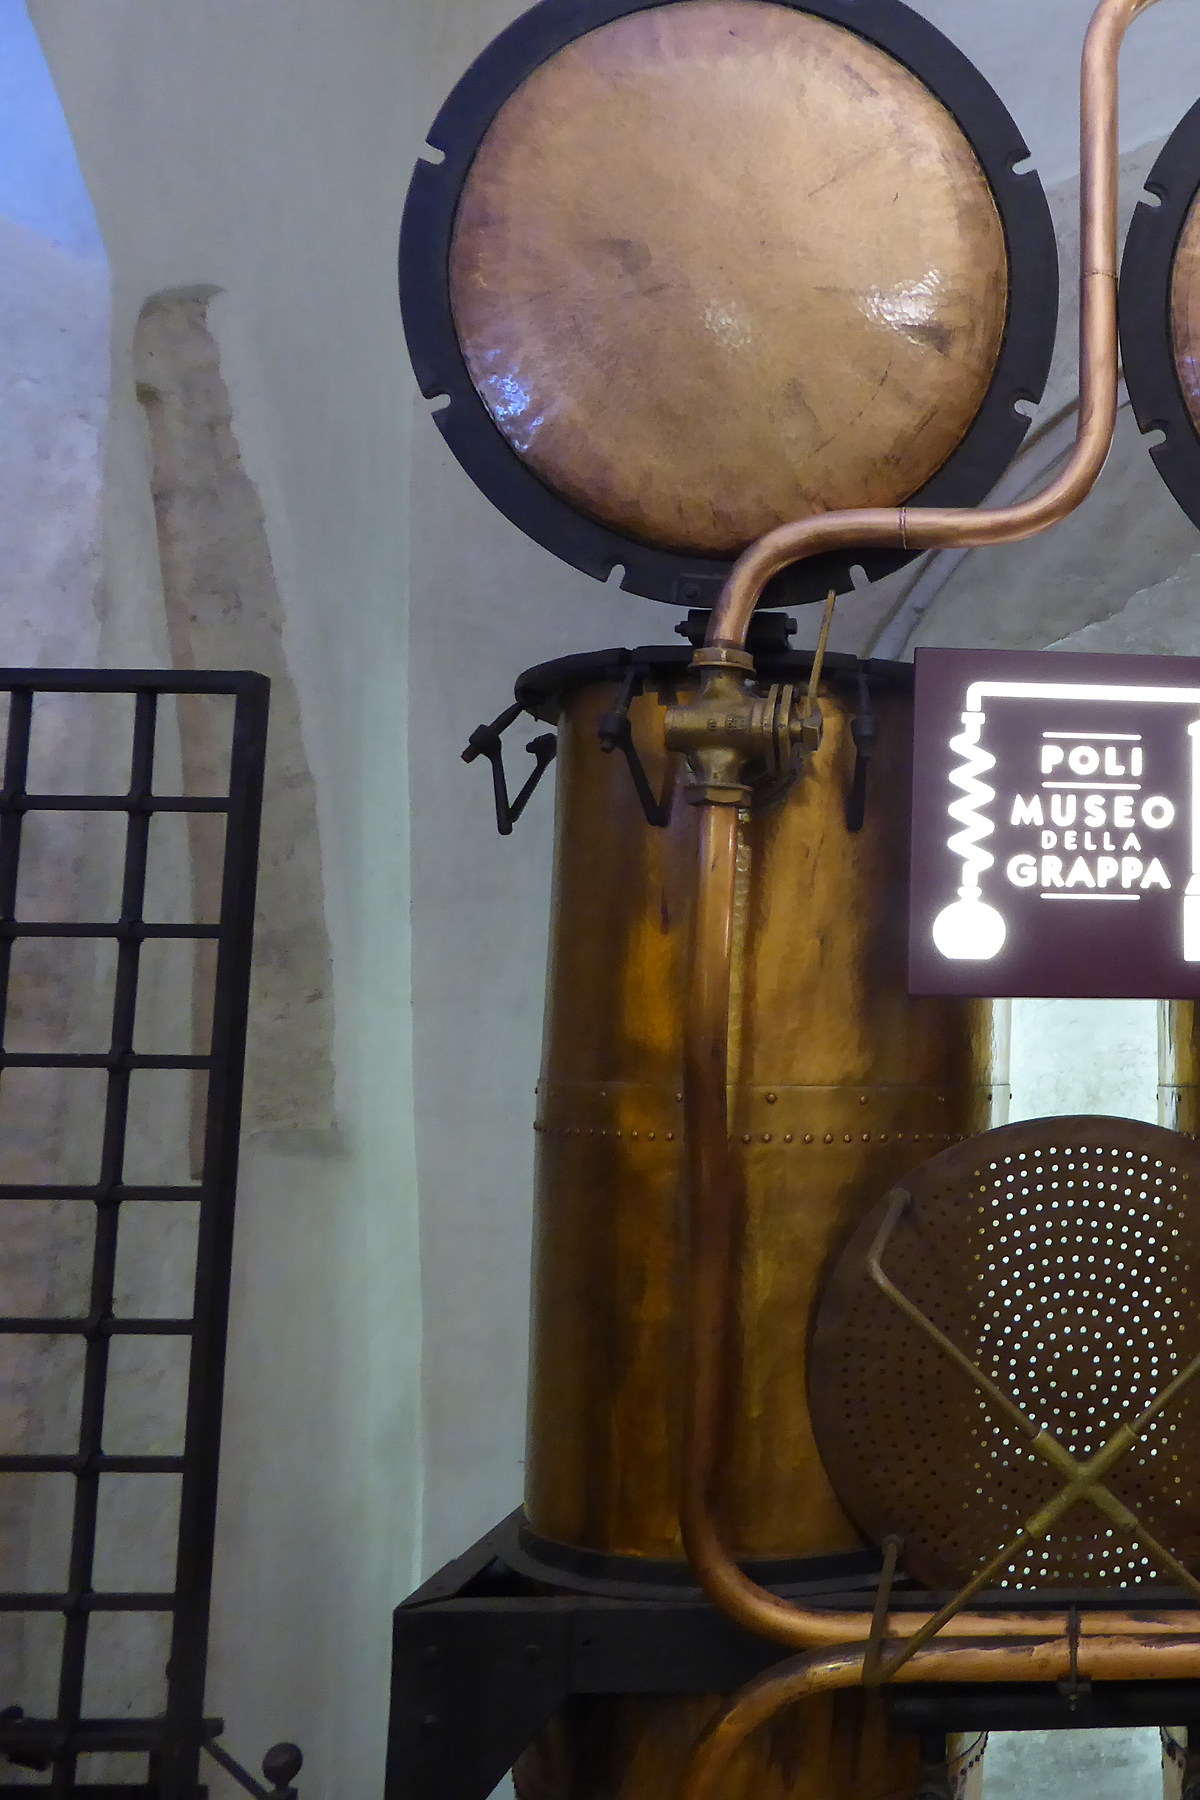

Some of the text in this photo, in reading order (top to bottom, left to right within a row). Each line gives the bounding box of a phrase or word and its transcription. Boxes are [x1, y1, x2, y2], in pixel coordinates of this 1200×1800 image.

[1040, 744, 1143, 777] POLI
[1010, 793, 1176, 829] MUSEO
[1040, 829, 1142, 852] DELLA
[1006, 853, 1172, 890] GRAPPA
